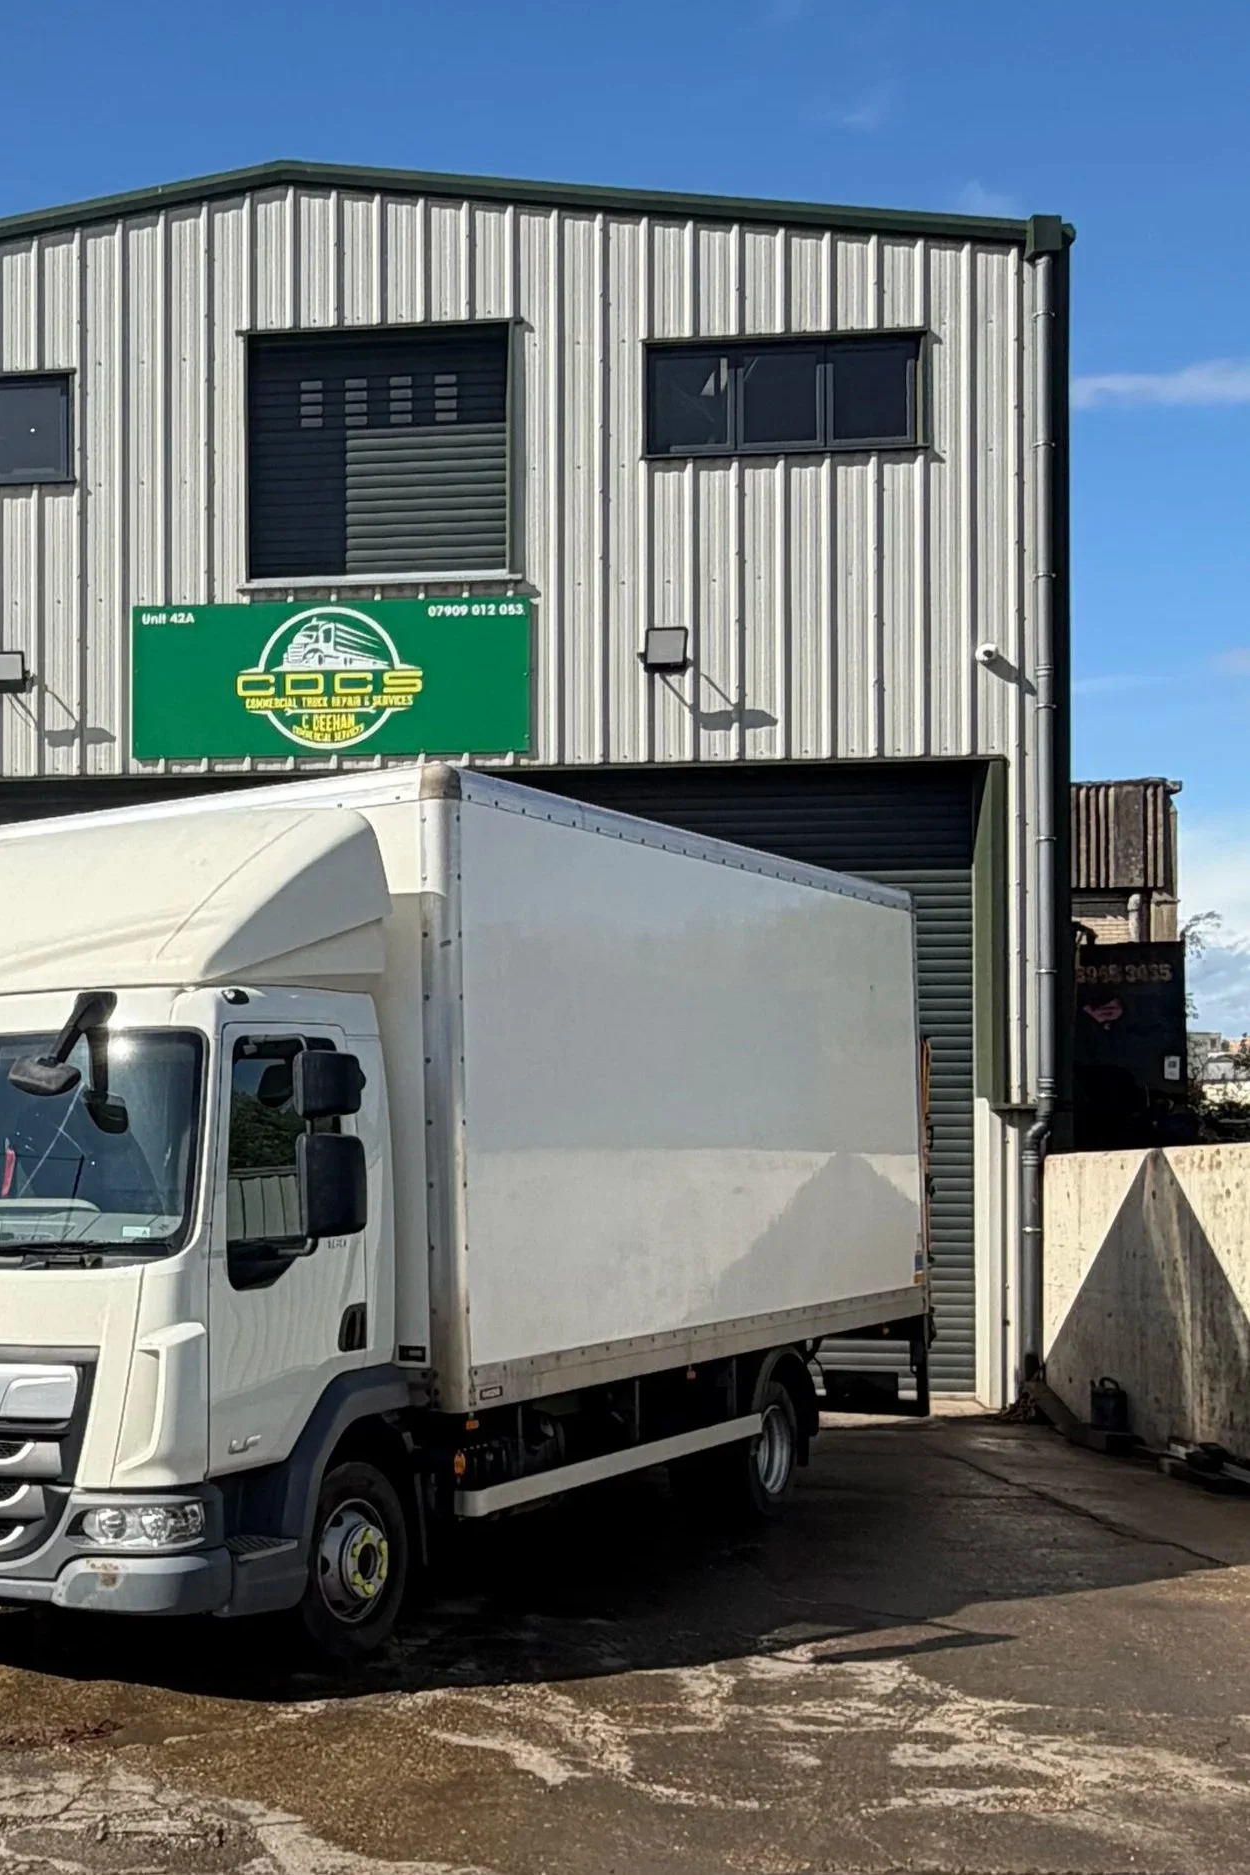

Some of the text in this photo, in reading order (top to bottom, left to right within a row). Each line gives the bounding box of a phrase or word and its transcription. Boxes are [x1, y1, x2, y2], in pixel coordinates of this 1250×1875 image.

[428, 603, 524, 617] 07909 012 053
[141, 612, 196, 625] Unit 42A
[236, 670, 423, 697] CDCS
[245, 697, 298, 709] COMMERCIAL
[301, 696, 328, 707] TRUCK
[331, 695, 361, 707] REPAIR
[372, 694, 414, 706] SERVICES
